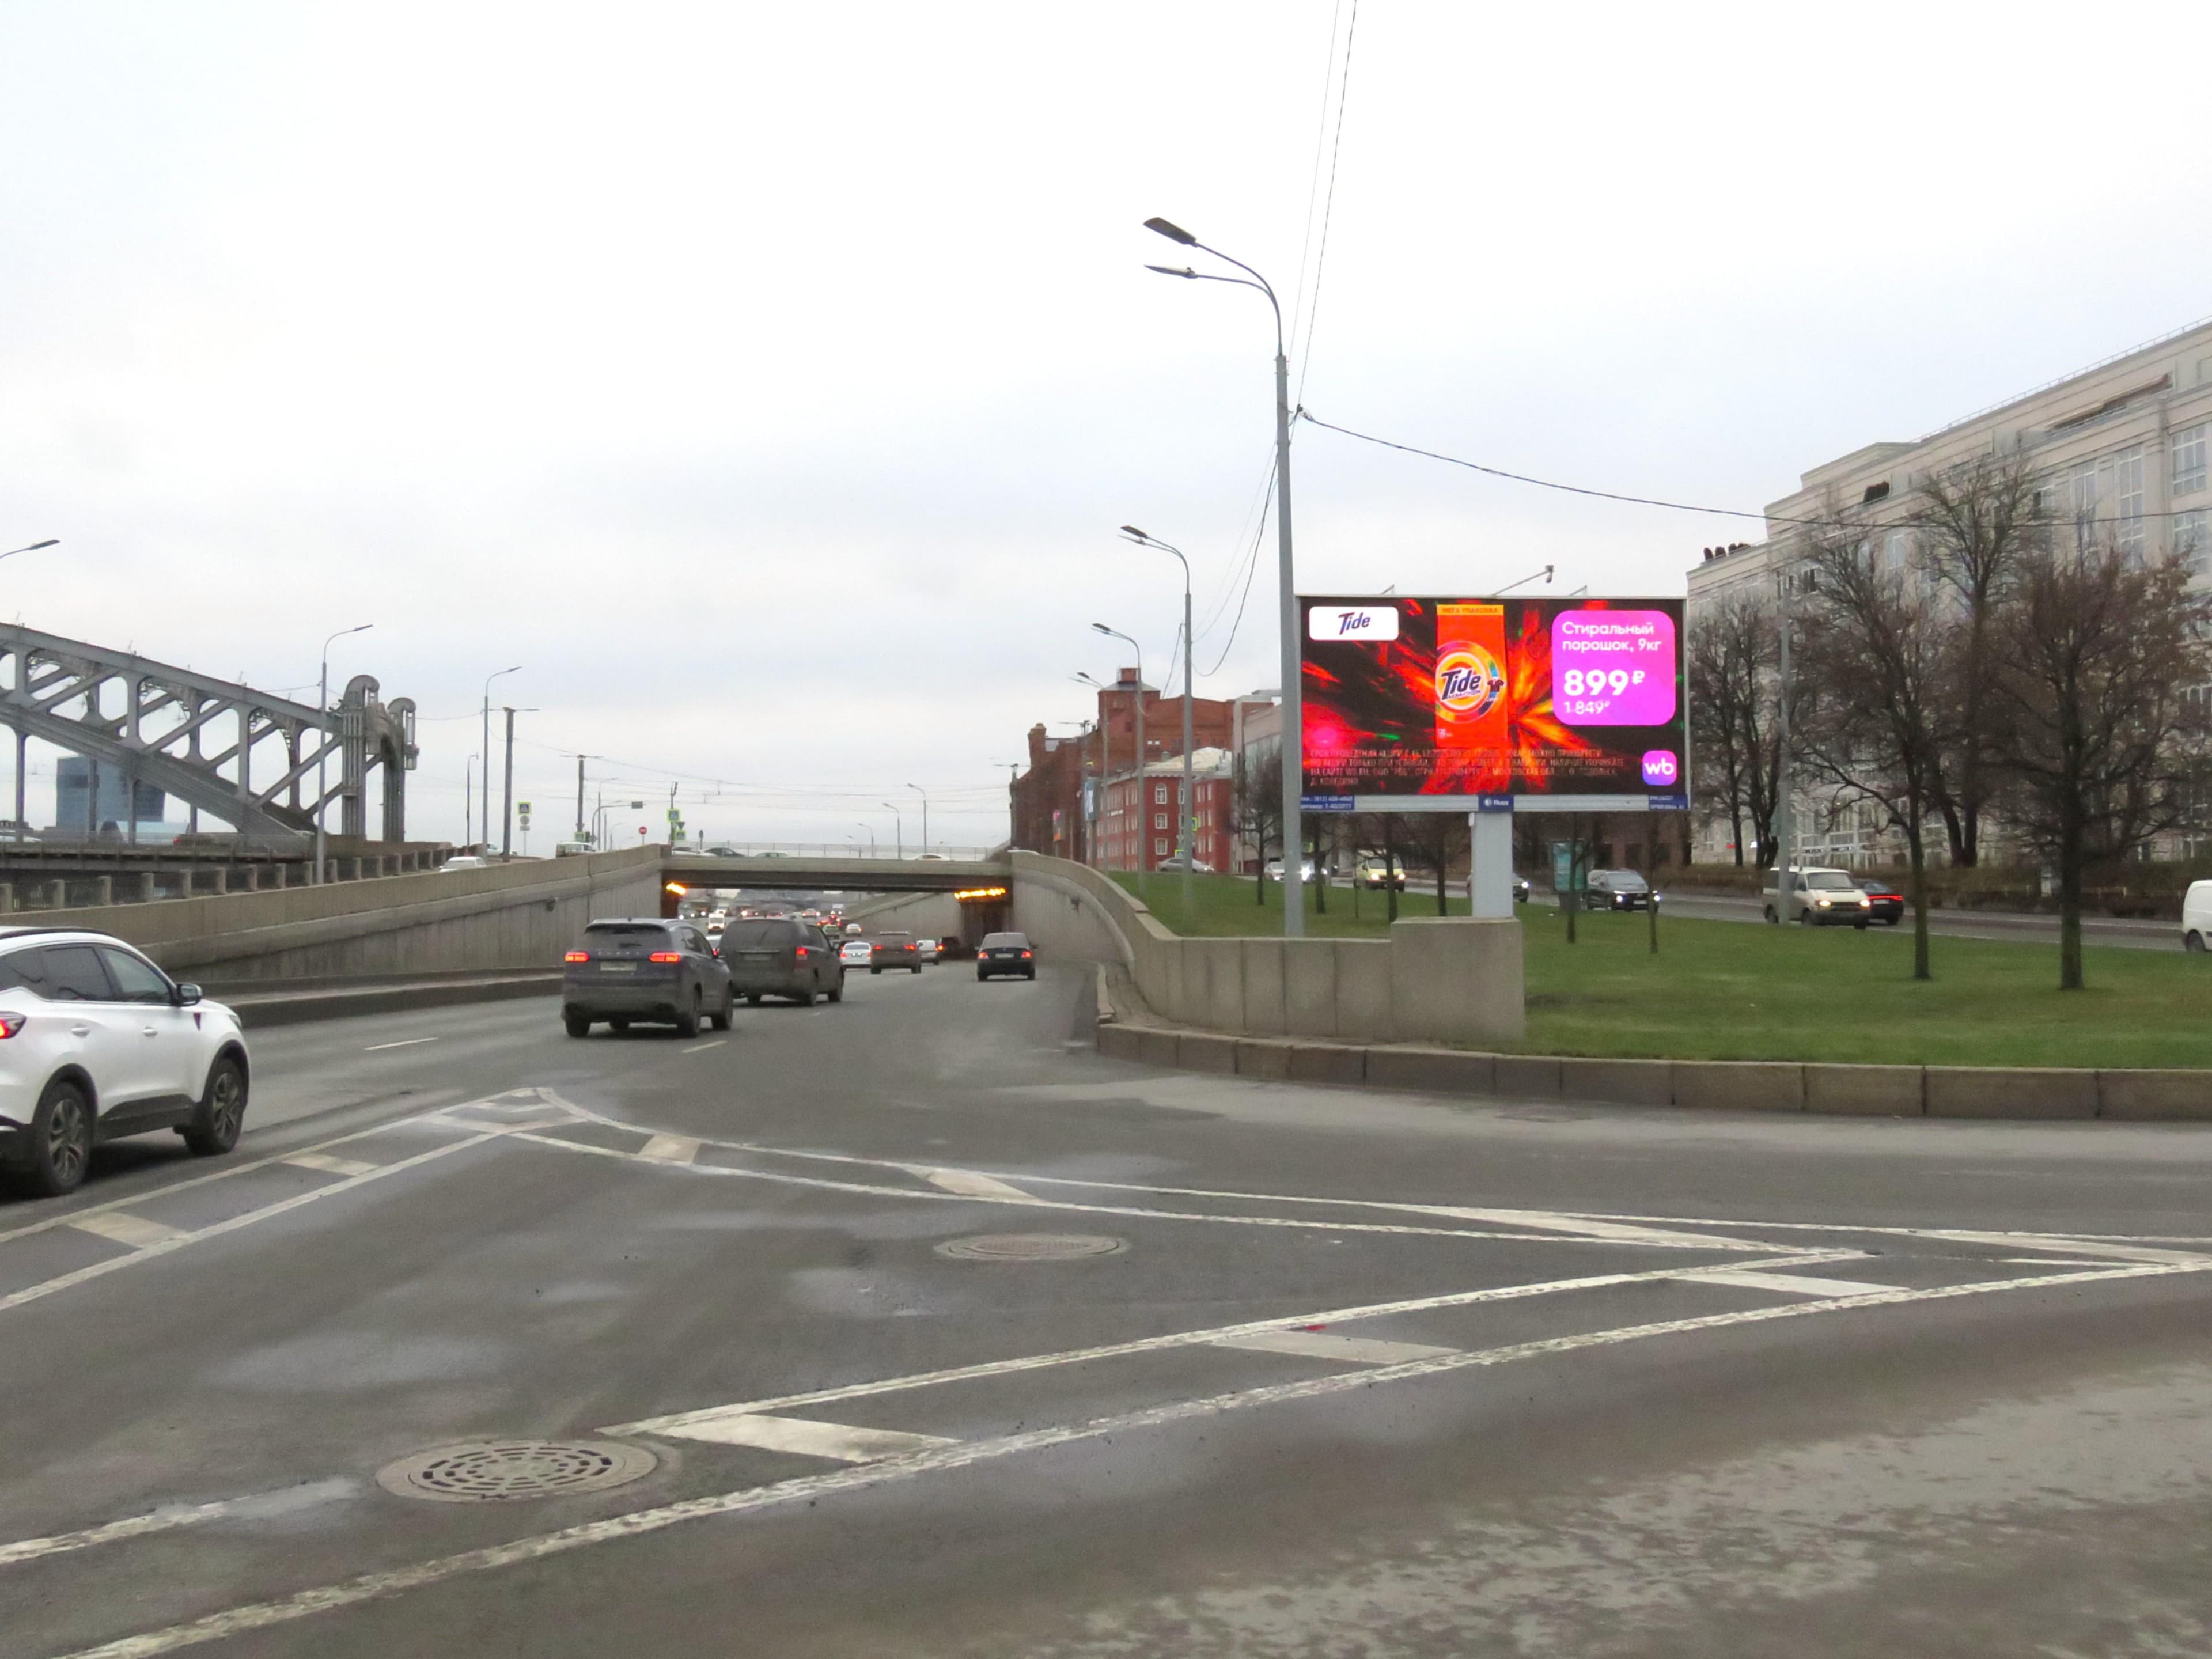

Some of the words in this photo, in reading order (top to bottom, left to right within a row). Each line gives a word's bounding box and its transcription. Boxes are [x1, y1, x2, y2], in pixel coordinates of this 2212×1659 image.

[1338, 612, 1371, 635] Tide
[1562, 621, 1654, 638] Стиральный
[1562, 640, 1634, 653] порошок,
[1637, 638, 1662, 651] 9кг
[1441, 668, 1481, 700] Tide
[1645, 757, 1674, 775] wb
